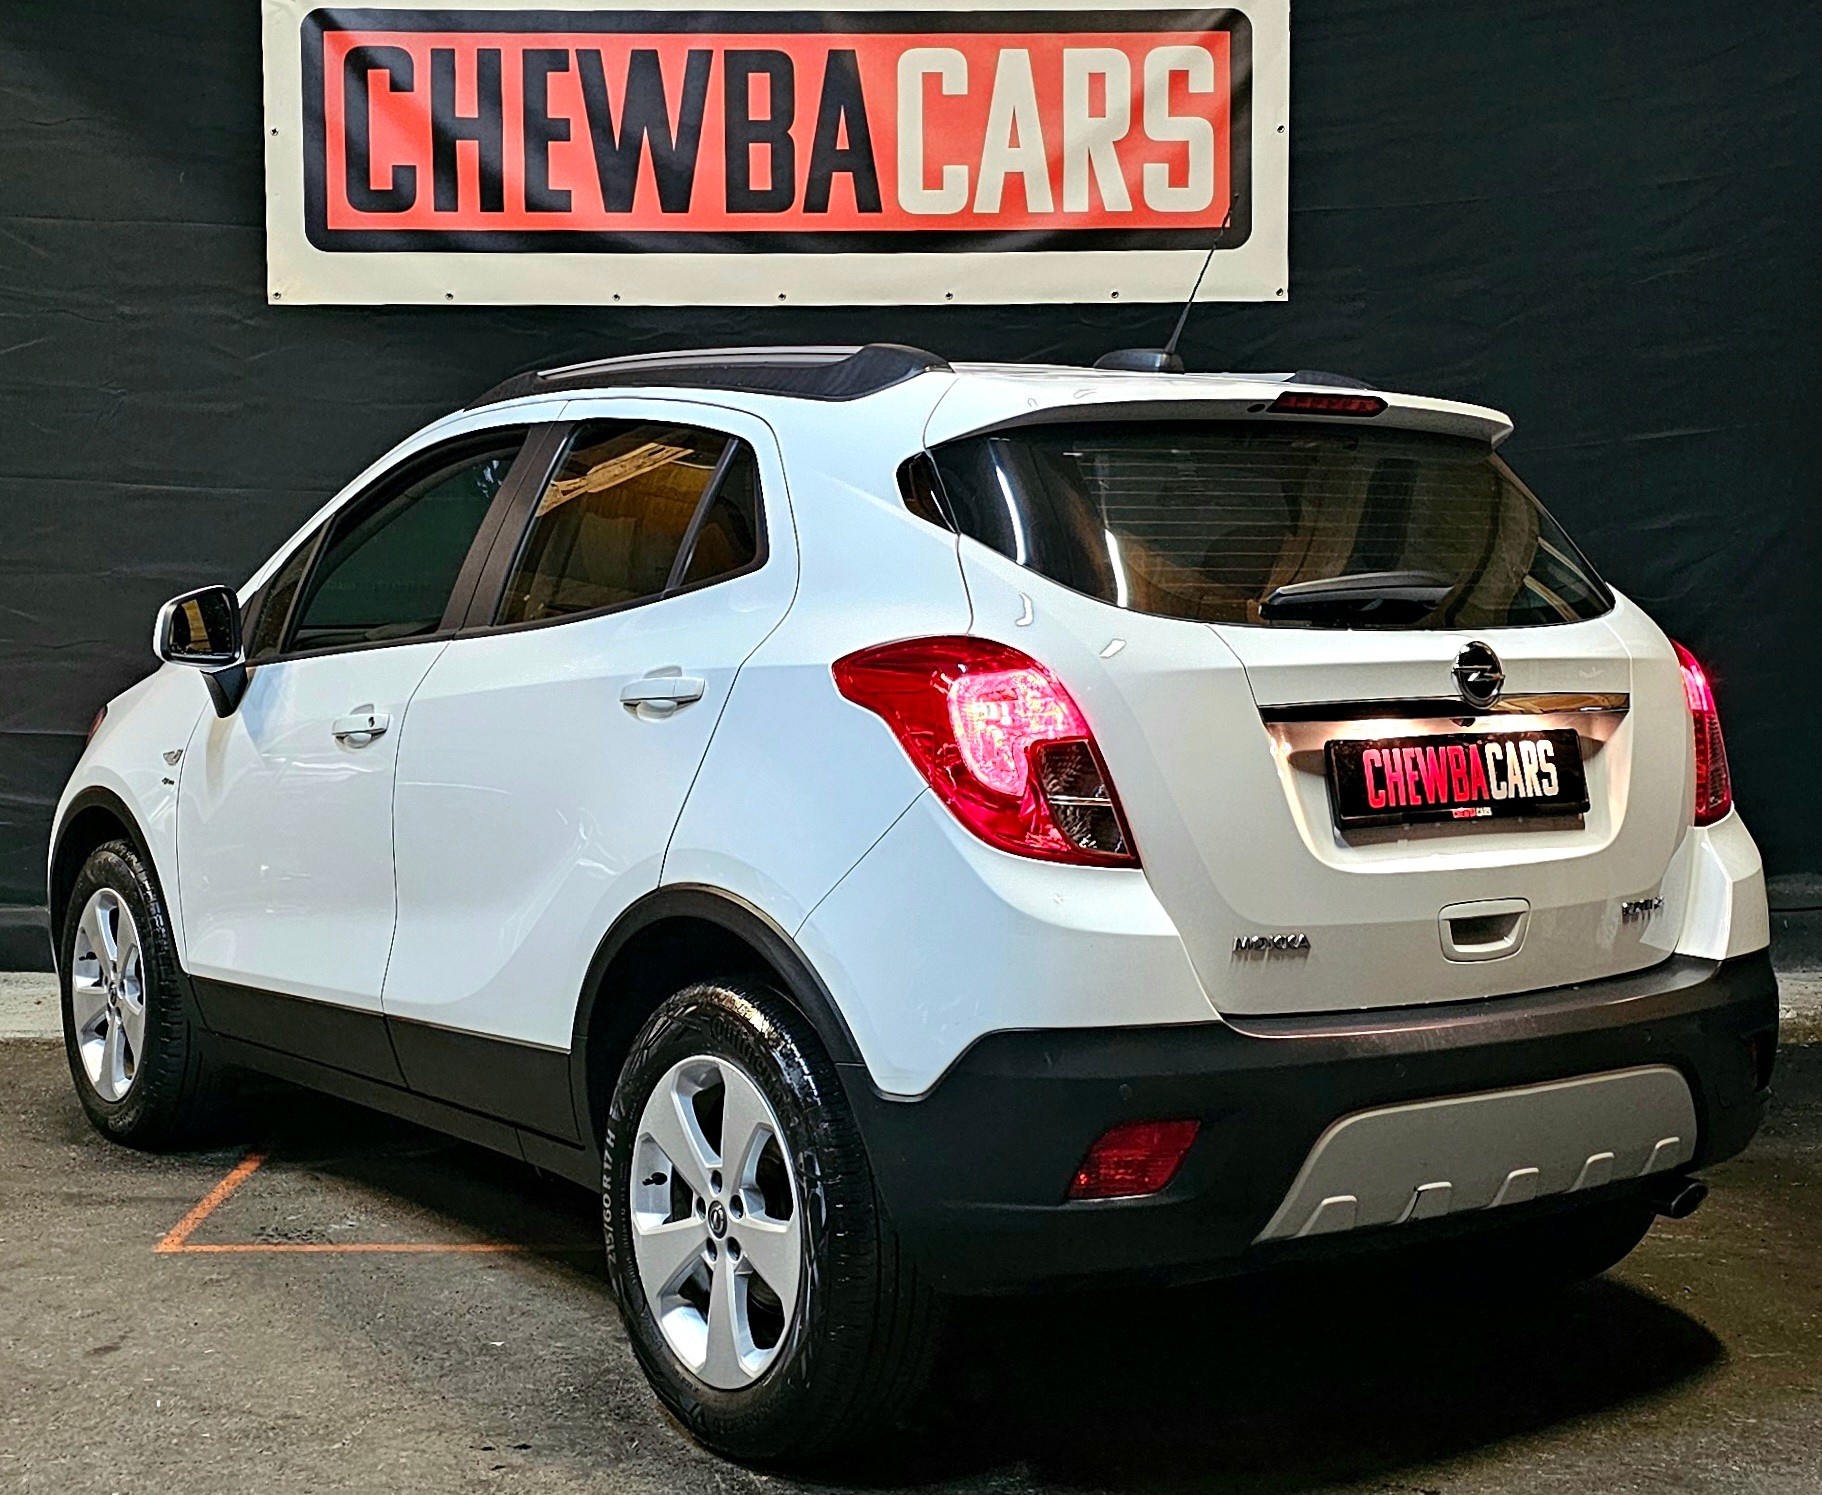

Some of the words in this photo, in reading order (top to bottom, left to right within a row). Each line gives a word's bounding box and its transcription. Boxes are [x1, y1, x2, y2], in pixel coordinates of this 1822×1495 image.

[342, 44, 1215, 217] CHEWBACARS
[1362, 740, 1559, 808] CHEWBACARS
[1232, 932, 1312, 954] MOKKA
